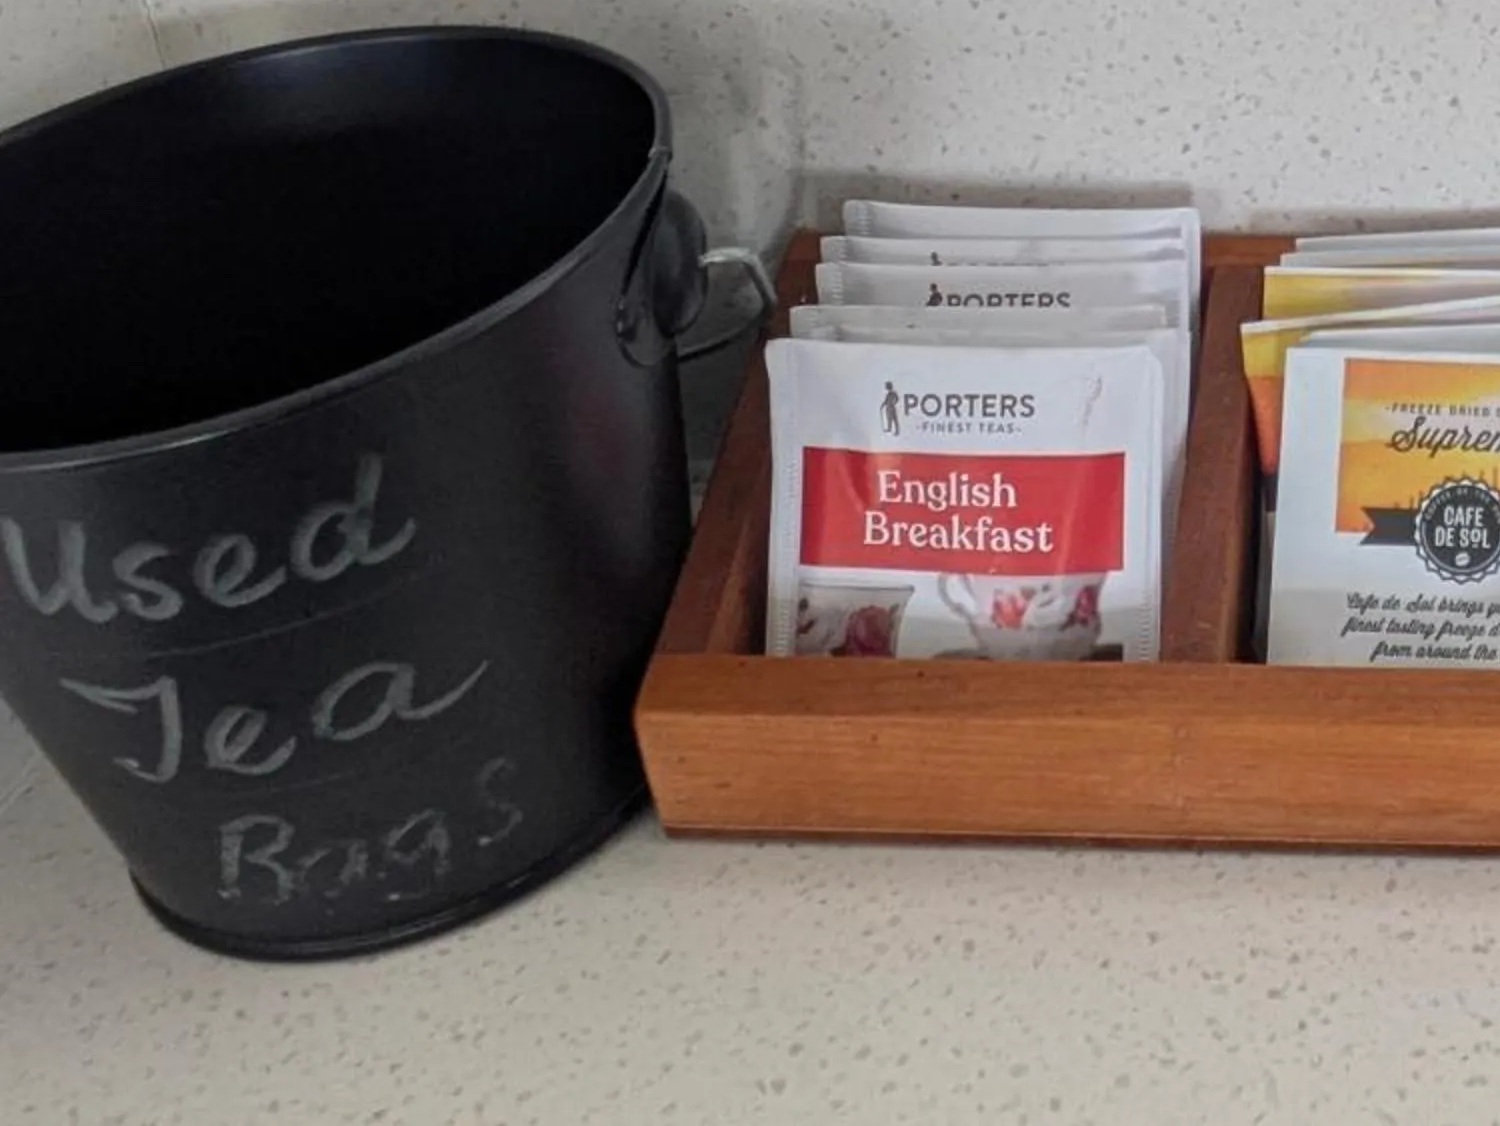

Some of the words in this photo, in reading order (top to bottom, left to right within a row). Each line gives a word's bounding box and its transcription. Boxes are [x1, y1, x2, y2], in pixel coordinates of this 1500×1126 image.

[903, 392, 1036, 418] PORTERS
[876, 469, 1018, 512] English
[863, 509, 1054, 554] Breakfast
[1443, 504, 1485, 527] CAFE
[1, 451, 417, 623] Used
[1434, 525, 1456, 548] DE
[1437, 596, 1484, 618] brings
[60, 660, 489, 783] Tea
